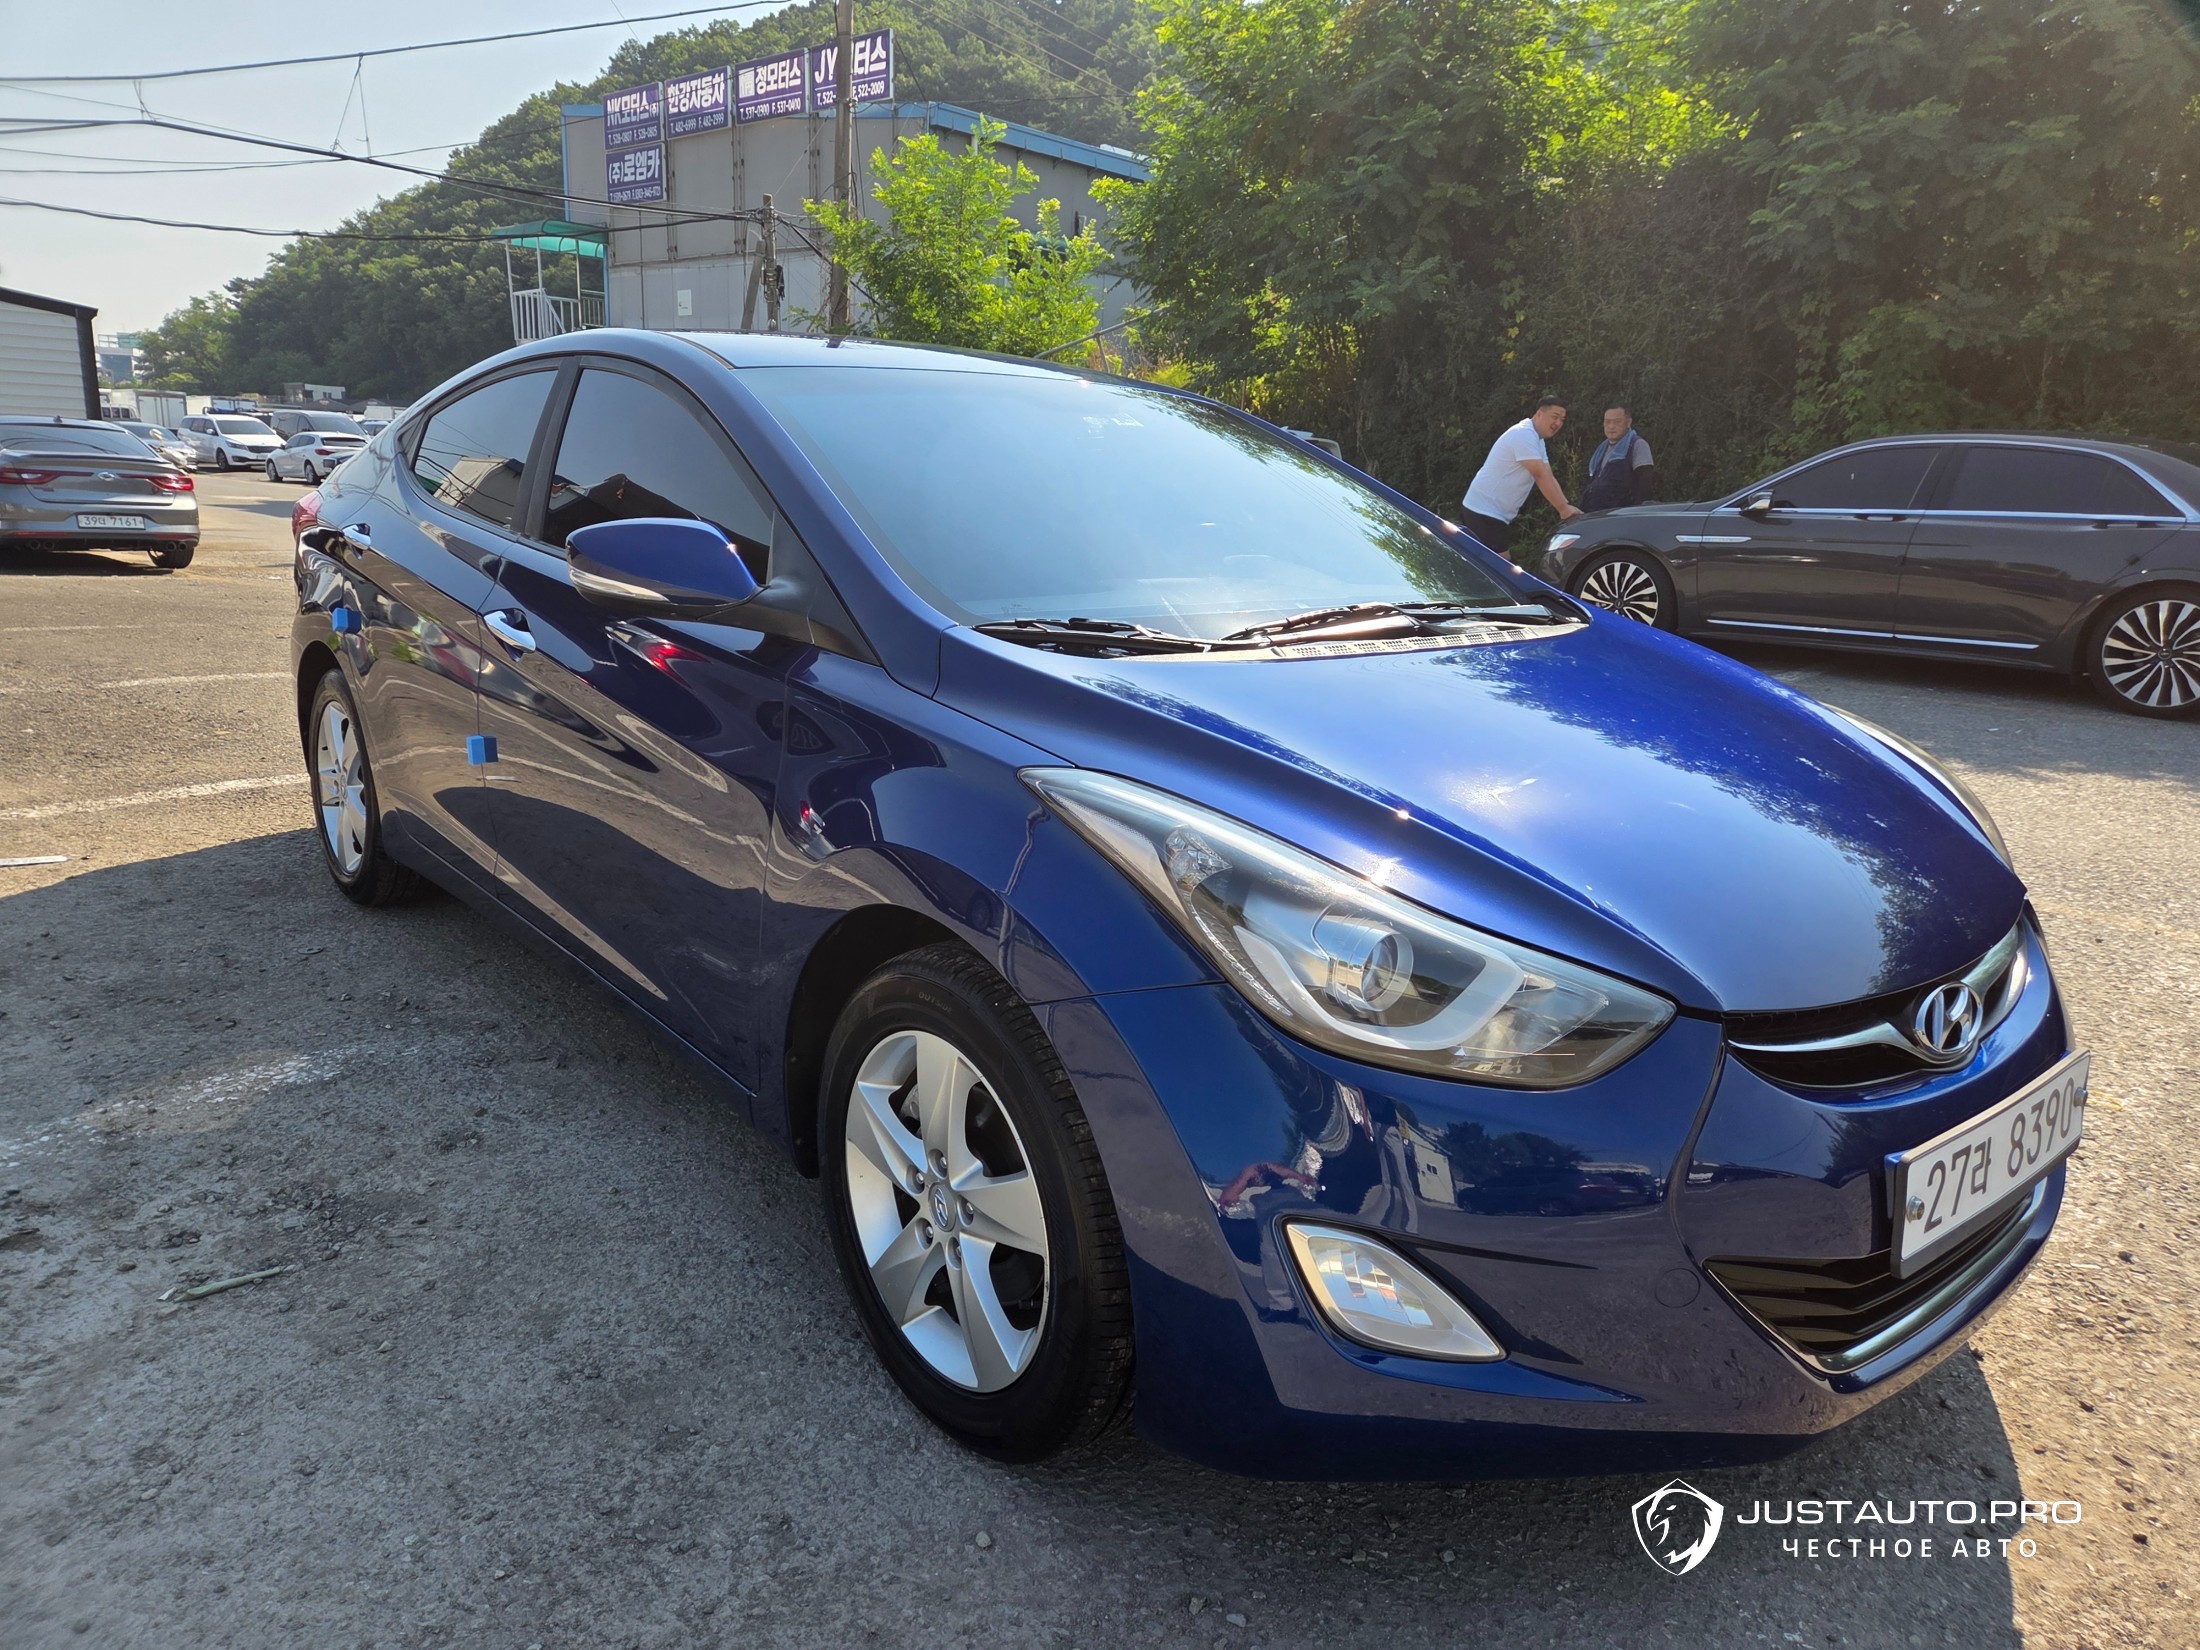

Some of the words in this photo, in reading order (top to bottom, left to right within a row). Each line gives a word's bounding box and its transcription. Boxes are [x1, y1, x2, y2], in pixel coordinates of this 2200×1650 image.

[814, 36, 887, 83] JY터스
[667, 73, 725, 114] 한강자동차
[110, 517, 137, 526] 7161
[1923, 1136, 1992, 1234] 27라
[2006, 1077, 2075, 1179] 8390
